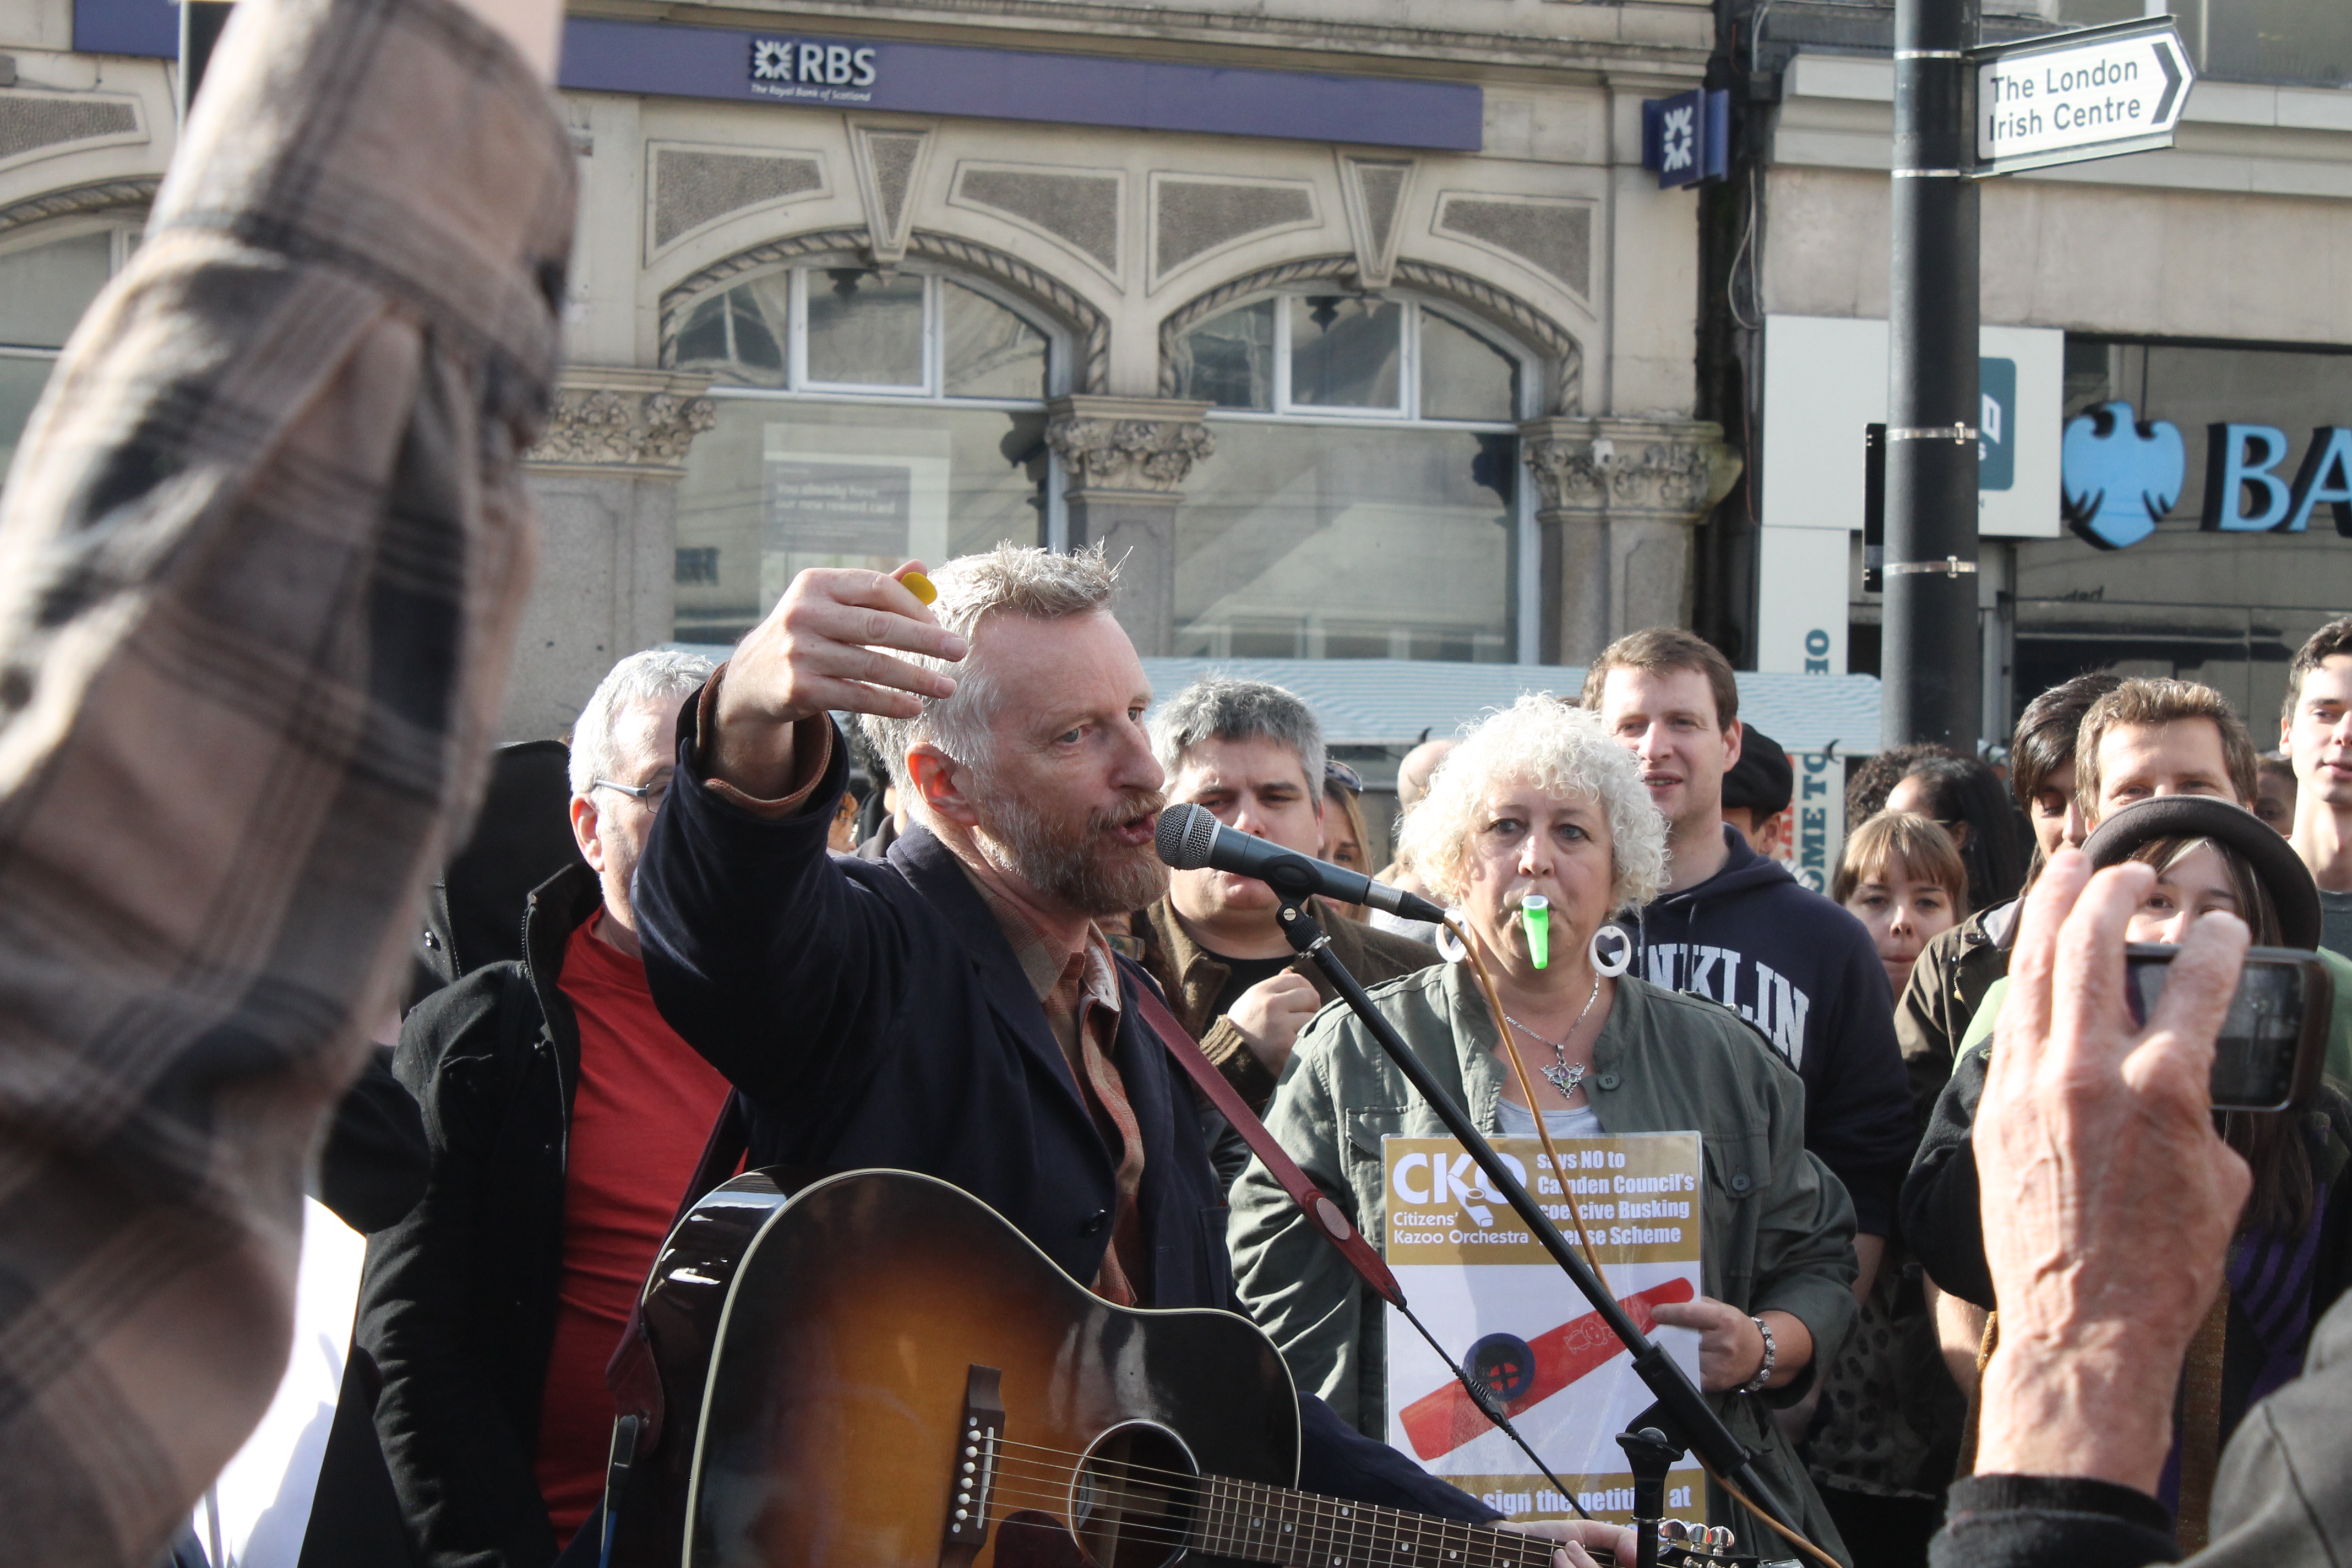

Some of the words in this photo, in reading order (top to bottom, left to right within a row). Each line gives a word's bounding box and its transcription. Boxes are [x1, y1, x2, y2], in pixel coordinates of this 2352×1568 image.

[799, 43, 876, 86] RBS
[1990, 75, 2035, 104] The
[2046, 59, 2138, 94] London
[1989, 108, 2043, 142] Irish
[2054, 96, 2141, 130] Centre
[2219, 422, 2352, 532] BA
[1608, 943, 1810, 1072] NKLIN
[1580, 1150, 1604, 1169] NO
[1608, 1151, 1626, 1168] to
[1392, 1152, 1527, 1227] CKO
[1613, 1173, 1695, 1194] Council's
[1538, 1201, 1615, 1220] coecive
[1618, 1199, 1690, 1219] Busking
[1393, 1229, 1444, 1244] Kazoo
[1448, 1229, 1529, 1244] Orchestra
[1609, 1226, 1681, 1245] Scheme
[1482, 1489, 1532, 1516] sign
[1536, 1489, 1573, 1513] the
[1578, 1487, 1635, 1512] petiti
[1669, 1485, 1691, 1508] at
